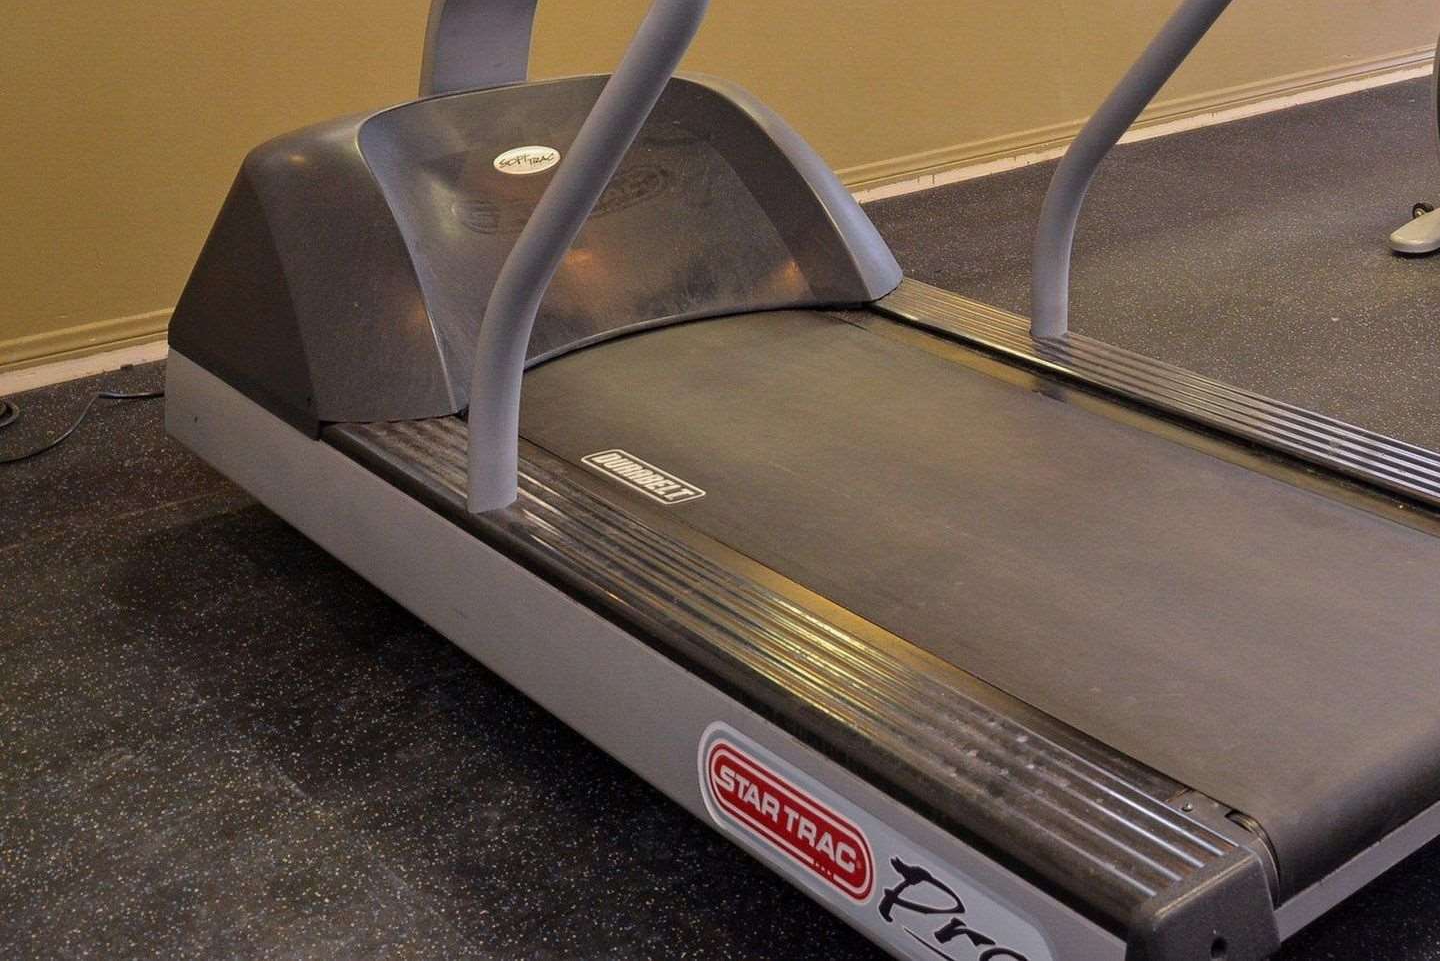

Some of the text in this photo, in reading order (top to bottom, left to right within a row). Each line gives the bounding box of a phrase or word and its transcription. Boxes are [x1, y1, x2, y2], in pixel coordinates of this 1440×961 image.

[592, 452, 696, 501] DURABELT
[714, 765, 857, 874] STAR TRAC
